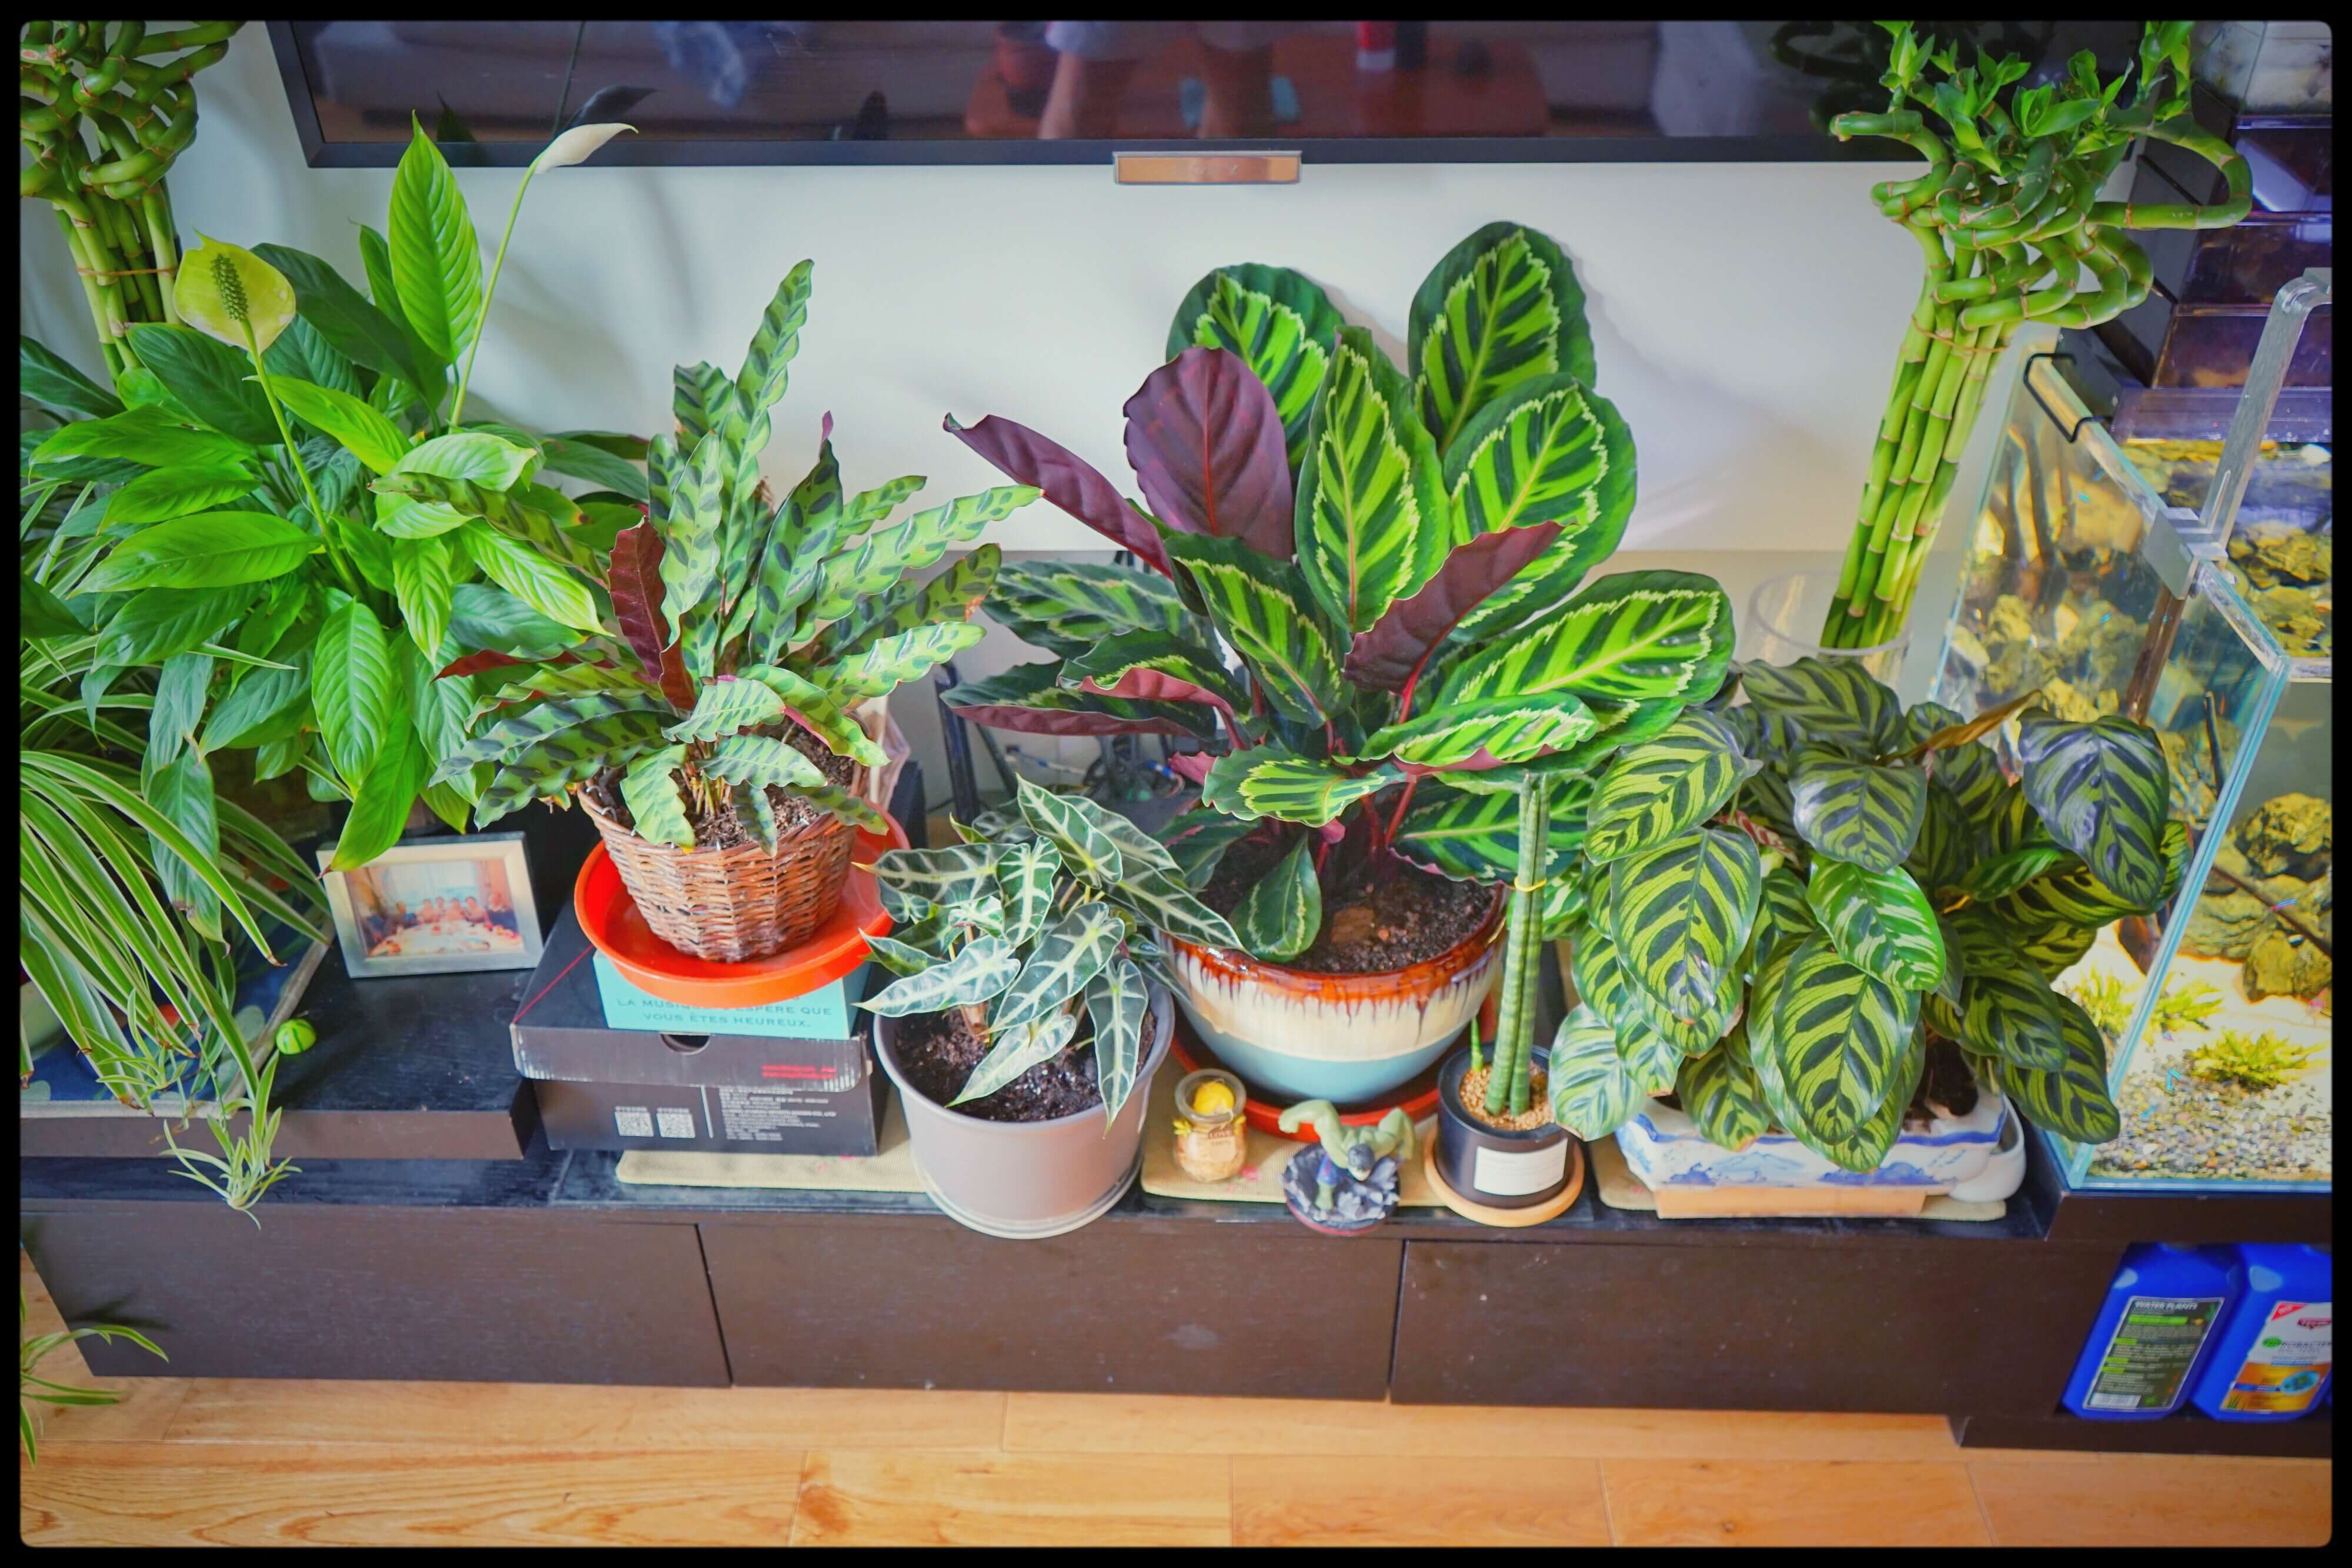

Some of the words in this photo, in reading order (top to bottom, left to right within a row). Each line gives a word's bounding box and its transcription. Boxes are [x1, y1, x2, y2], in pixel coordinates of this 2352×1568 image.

[800, 1007, 832, 1016] QUE
[643, 1013, 683, 1022] VOUS
[690, 1012, 728, 1024] ÊTES
[734, 1017, 811, 1028] HEUREUX.
[2134, 1300, 2165, 1310] WATER
